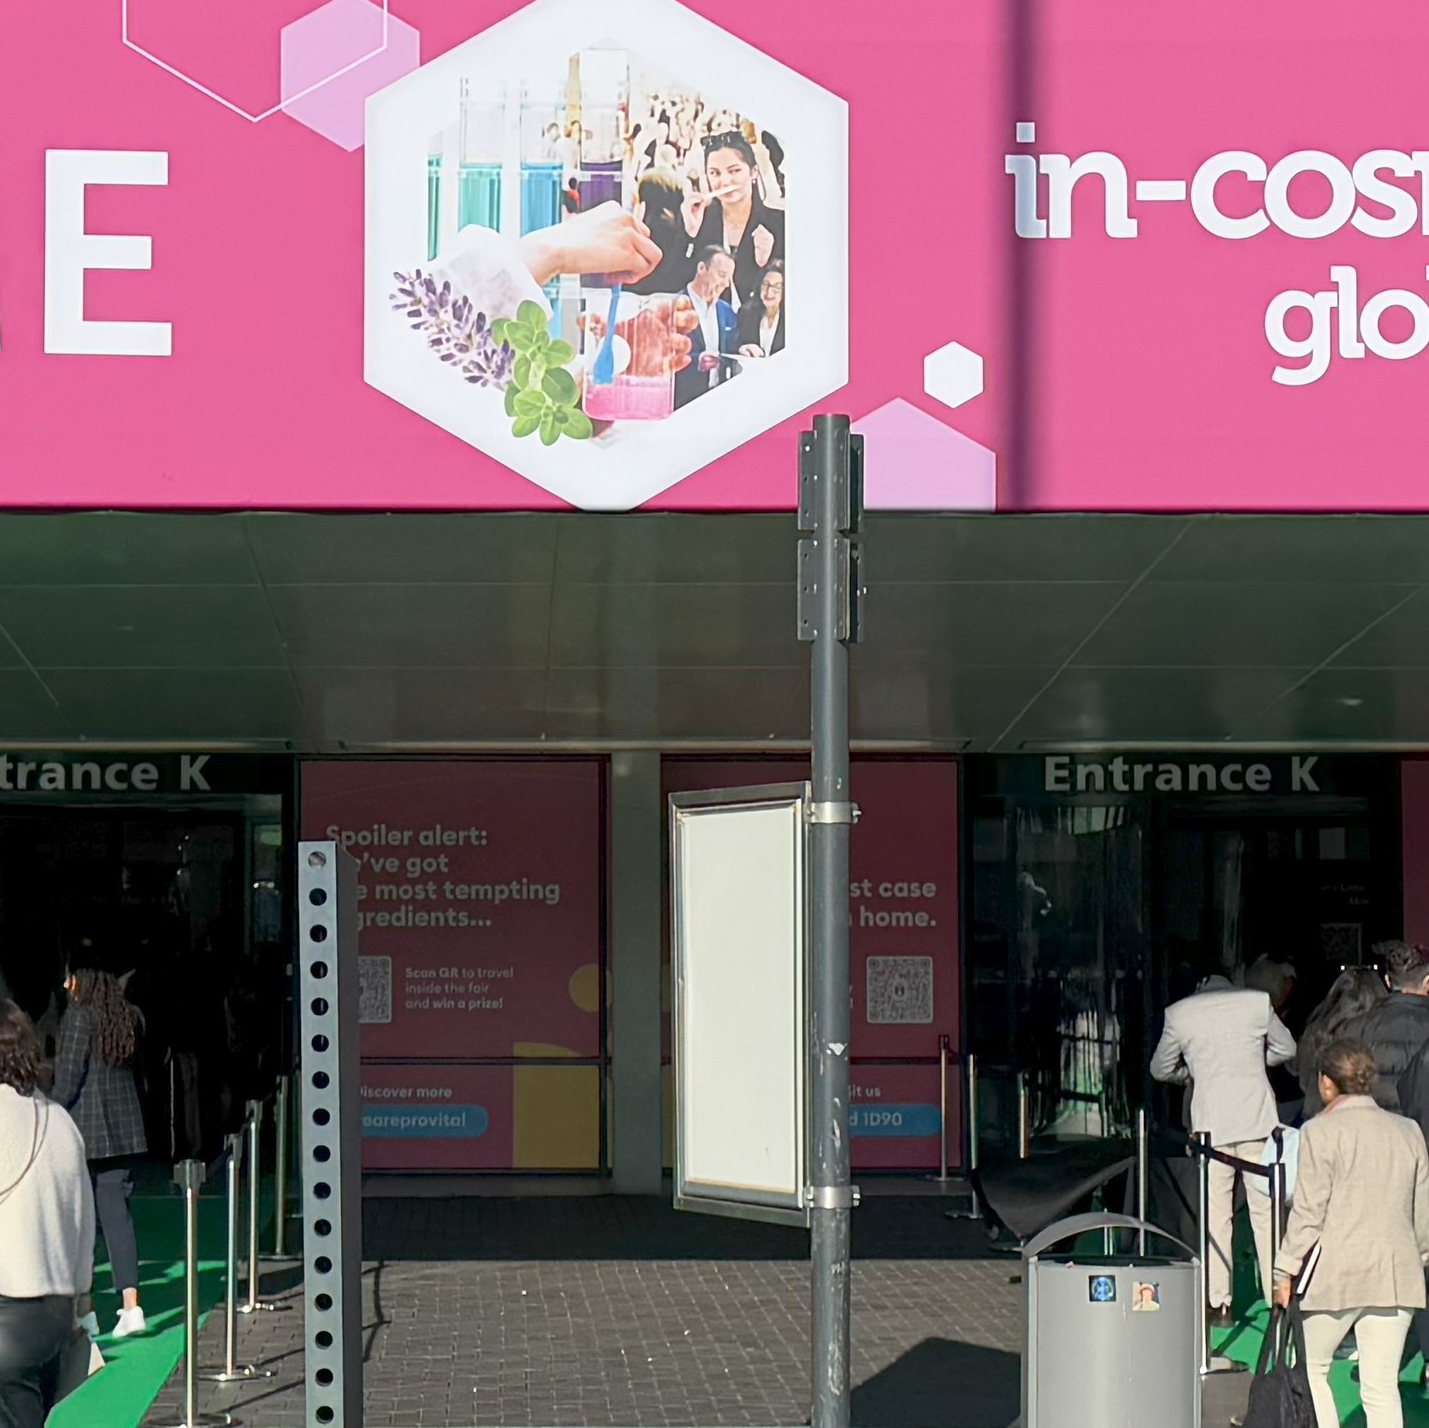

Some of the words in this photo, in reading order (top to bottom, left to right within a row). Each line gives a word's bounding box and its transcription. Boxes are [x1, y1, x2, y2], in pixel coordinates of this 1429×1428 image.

[179, 754, 213, 791] K
[1043, 755, 1272, 792] Entrance
[1290, 755, 1321, 792] K
[326, 824, 412, 850] Spoiler
[419, 824, 488, 846] alert:
[406, 854, 449, 878] got
[374, 881, 437, 900] most
[443, 878, 560, 905] tempting
[878, 881, 937, 899] case
[859, 904, 937, 928] home.
[404, 966, 437, 979] Scan
[438, 966, 460, 979] QR
[461, 966, 475, 979] to
[476, 965, 514, 979] travel
[405, 980, 442, 994] inside
[444, 980, 466, 994] the
[467, 981, 490, 994] fair
[404, 997, 430, 1009] and
[431, 996, 455, 1009] win
[457, 999, 466, 1009] a
[467, 996, 504, 1012] prize!
[360, 1084, 413, 1099] iscover
[415, 1086, 453, 1099] more
[865, 1087, 882, 1098] us
[864, 1112, 903, 1126] 1D90
